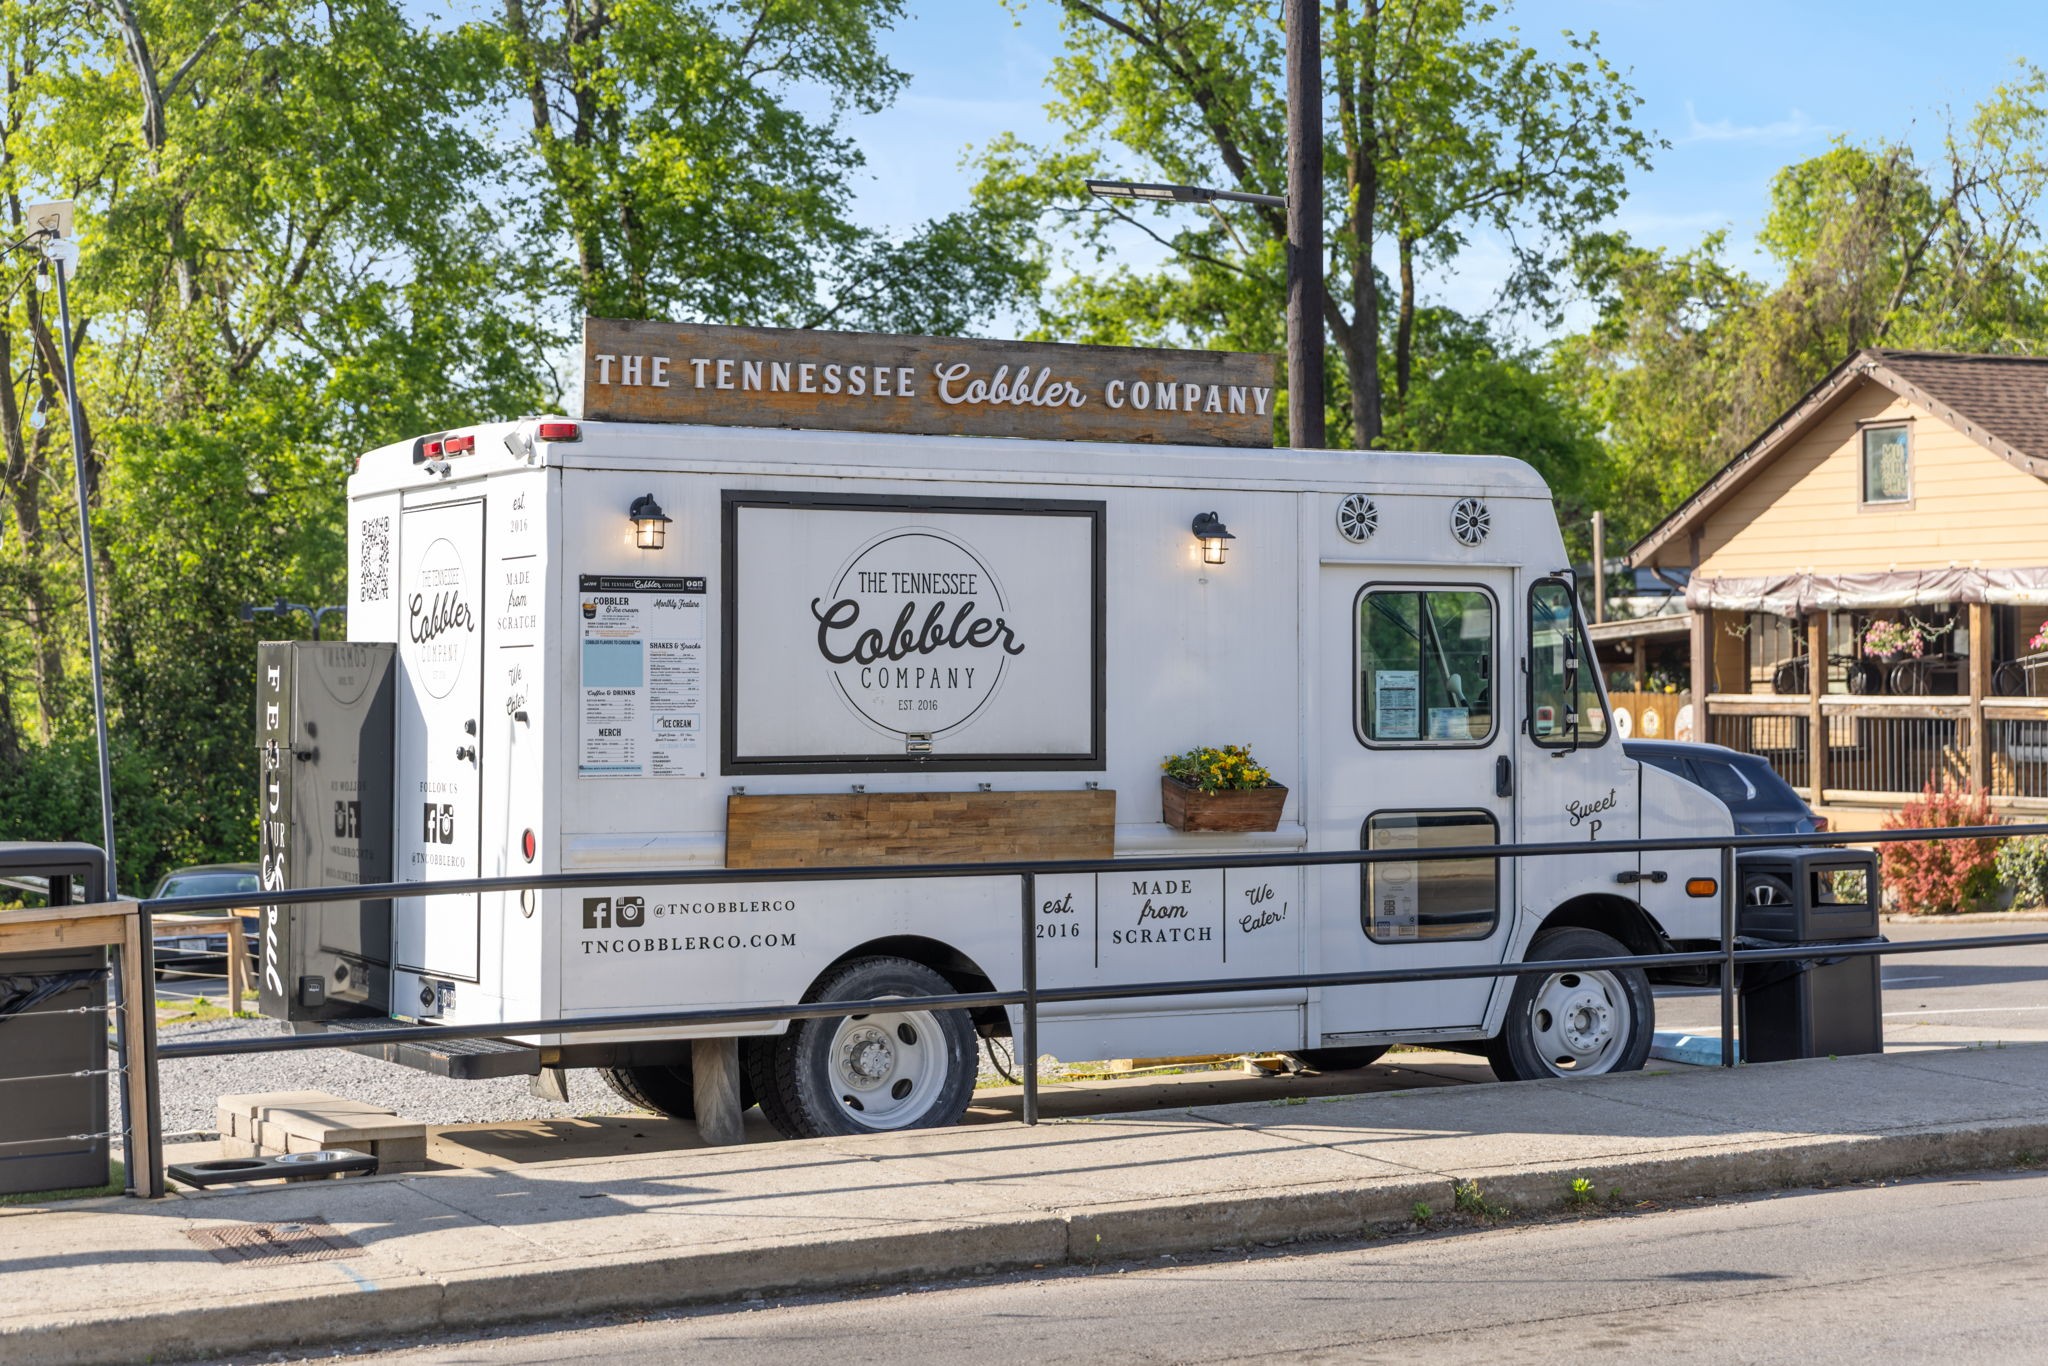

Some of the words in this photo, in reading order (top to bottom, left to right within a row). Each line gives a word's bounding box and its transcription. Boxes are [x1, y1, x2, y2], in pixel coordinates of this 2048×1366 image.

[594, 353, 671, 388] THE
[689, 357, 916, 398] TENNESSEE
[934, 361, 1087, 408] Cobbler
[1104, 379, 1271, 416] COMPANY
[510, 519, 528, 533] 2016
[506, 571, 530, 586] MADE
[634, 580, 661, 589] Cobbler
[858, 571, 887, 593] THE
[891, 572, 978, 595] TENNESSEE
[507, 589, 528, 613] from
[593, 596, 629, 606] COBBLER
[653, 598, 677, 610] Monthly
[678, 598, 700, 610] Feature
[408, 590, 475, 644] Cobbler
[497, 615, 537, 630] SCRATCH
[811, 597, 1025, 666] Cobbler
[422, 644, 458, 663] COMPANY
[508, 664, 523, 687] We
[860, 667, 975, 689] COMPANY
[898, 699, 915, 711] EST.
[918, 699, 938, 711] 2016
[598, 728, 622, 737] MERCH
[662, 719, 672, 728] ICE
[672, 719, 692, 728] CREAM
[419, 781, 447, 793] FOLLOW
[449, 783, 458, 794] US
[1565, 787, 1617, 827] Sweet
[1589, 819, 1603, 841] P
[411, 852, 466, 868] @TNCOBBLERCO
[1131, 879, 1192, 896] MADE
[1245, 883, 1275, 906] We
[653, 900, 796, 919] @TNCOBBLERCO
[1042, 892, 1075, 914] est.
[1137, 898, 1189, 926] from
[1238, 902, 1288, 933] Cater!
[1036, 923, 1080, 938] 2016
[1112, 927, 1212, 945] SCRATCH
[581, 933, 797, 954] TNCOBBLERCO.COM
